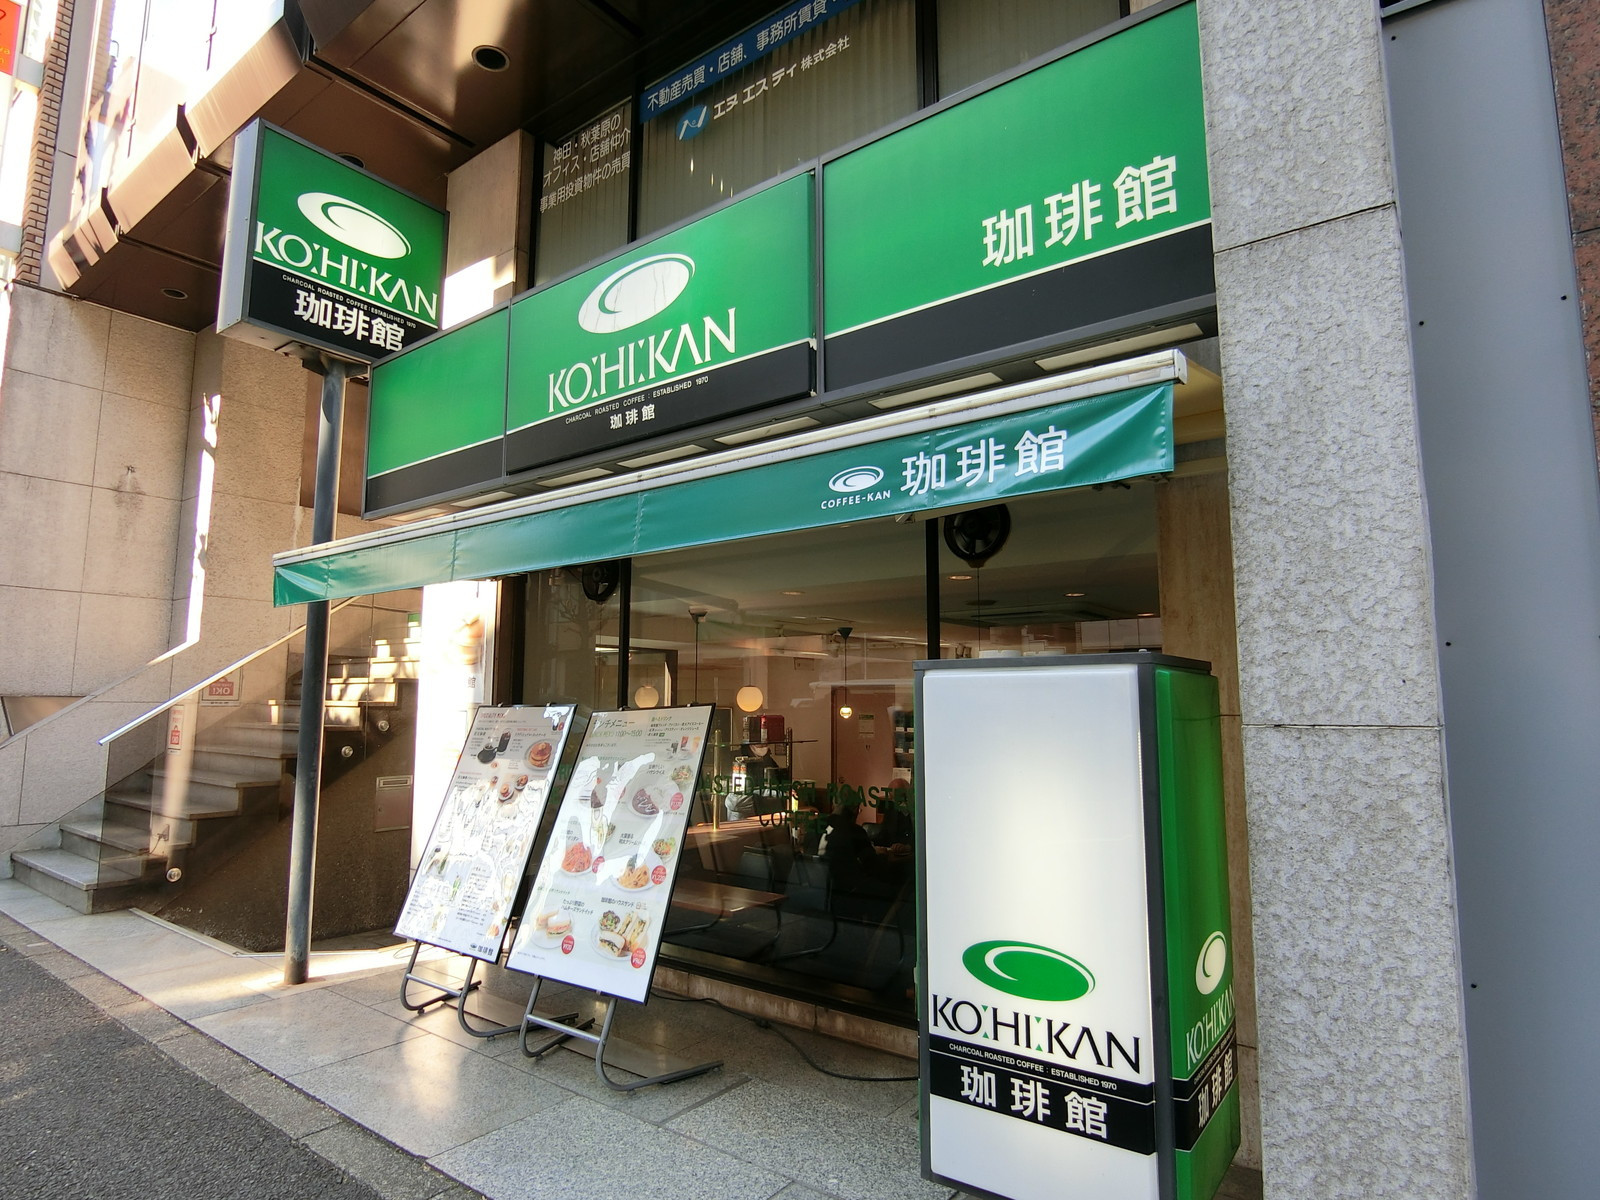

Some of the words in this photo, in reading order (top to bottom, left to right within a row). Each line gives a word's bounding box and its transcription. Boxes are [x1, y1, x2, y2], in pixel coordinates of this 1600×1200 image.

[543, 127, 631, 188] オフィス・店舗仲介
[553, 113, 621, 165] 神田・秋葉原の
[540, 150, 631, 213] 事業用投資物件の売買
[982, 155, 1177, 267] 珈琲館
[282, 274, 315, 291] CHARCOAL
[317, 287, 344, 302] ROASTED
[346, 298, 368, 311] COFFEE
[371, 306, 405, 324] ESTABLISHED
[406, 321, 417, 329] 1970
[294, 289, 405, 352] 珈琲館
[565, 411, 592, 425] CHARCOAL
[594, 402, 620, 415] ROASTED
[622, 394, 645, 406] COFFEE
[652, 380, 692, 398] ESTABLISHED
[696, 376, 709, 386] 1970
[609, 403, 655, 430] 珈琲館
[900, 426, 1067, 496] 珈琲館
[820, 489, 891, 510] COFFEE-KAN
[949, 1043, 983, 1058] CHARCOAL
[984, 1051, 1015, 1065] ROASTED
[1016, 1058, 1044, 1073] COFFEE
[1050, 1068, 1100, 1087] ESTABLISHED
[1101, 1080, 1117, 1091] 1970
[1198, 1048, 1233, 1129] 珈琲館
[960, 1065, 1108, 1139] 珈琲館
